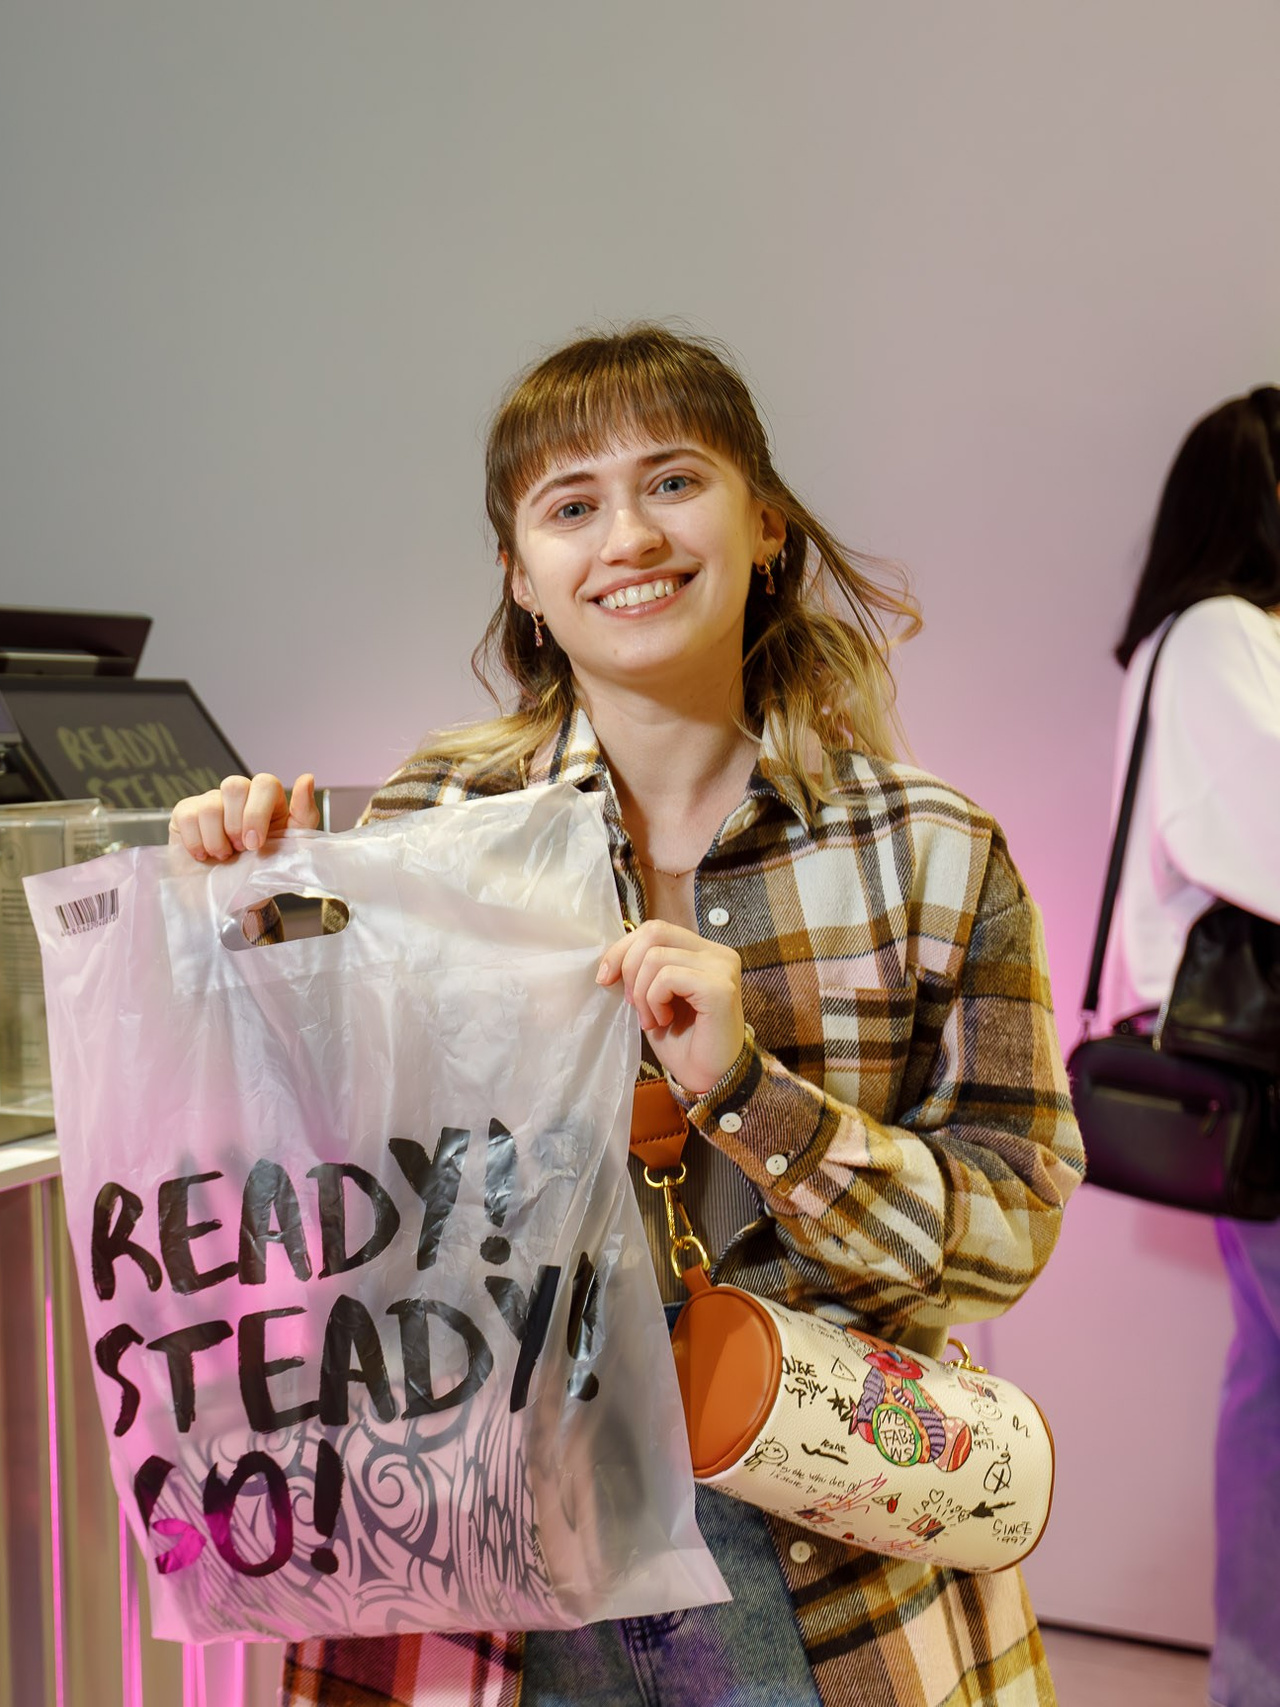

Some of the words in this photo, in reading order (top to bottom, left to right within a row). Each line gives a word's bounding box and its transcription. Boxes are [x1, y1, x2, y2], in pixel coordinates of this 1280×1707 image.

[57, 722, 187, 772] READY!
[91, 1117, 518, 1301] READY!
[95, 1252, 600, 1437] STEADY!
